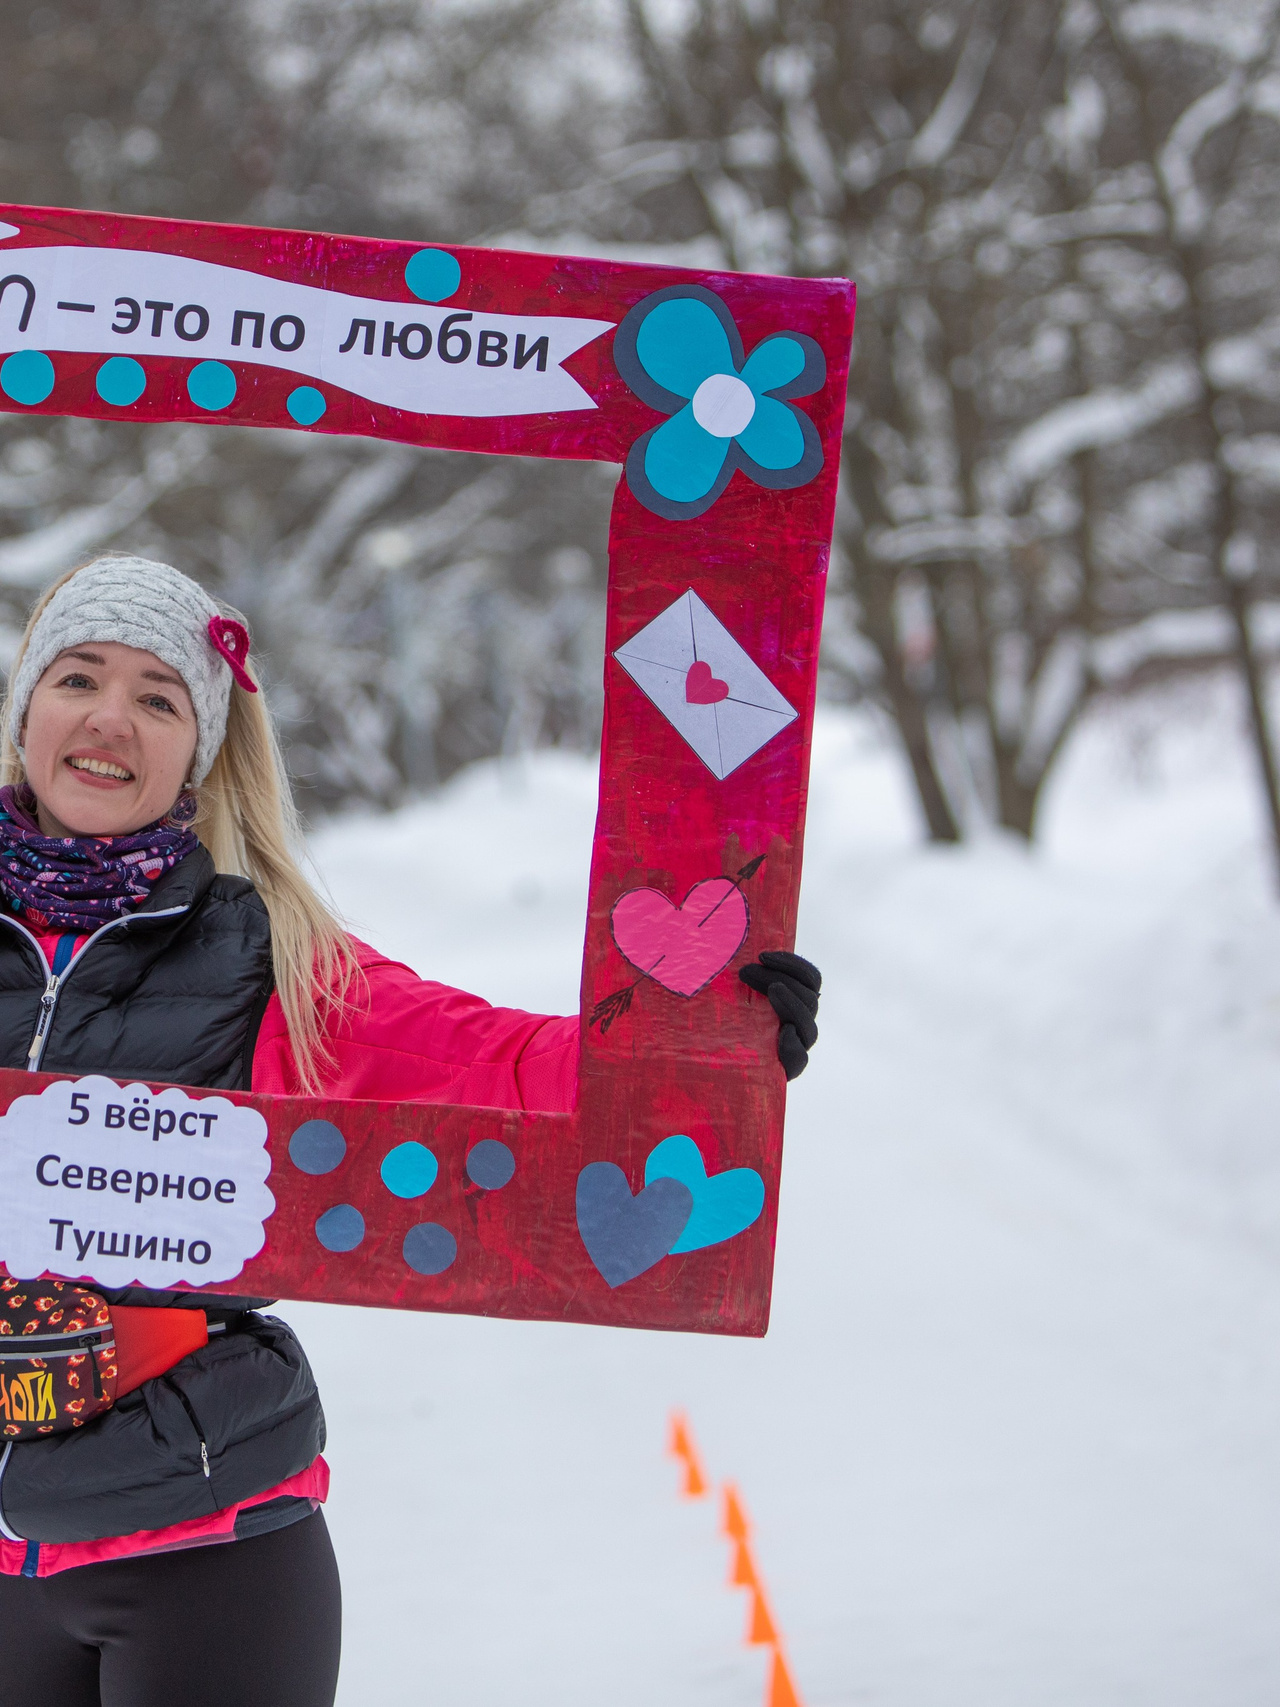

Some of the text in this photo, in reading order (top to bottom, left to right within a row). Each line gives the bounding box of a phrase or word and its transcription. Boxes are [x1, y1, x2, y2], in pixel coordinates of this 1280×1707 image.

[111, 297, 210, 342] это
[231, 309, 306, 352] по
[338, 312, 550, 373] любви
[67, 1092, 218, 1142] 5 вёрст
[35, 1154, 237, 1204] Северное
[48, 1218, 212, 1265] Тушино
